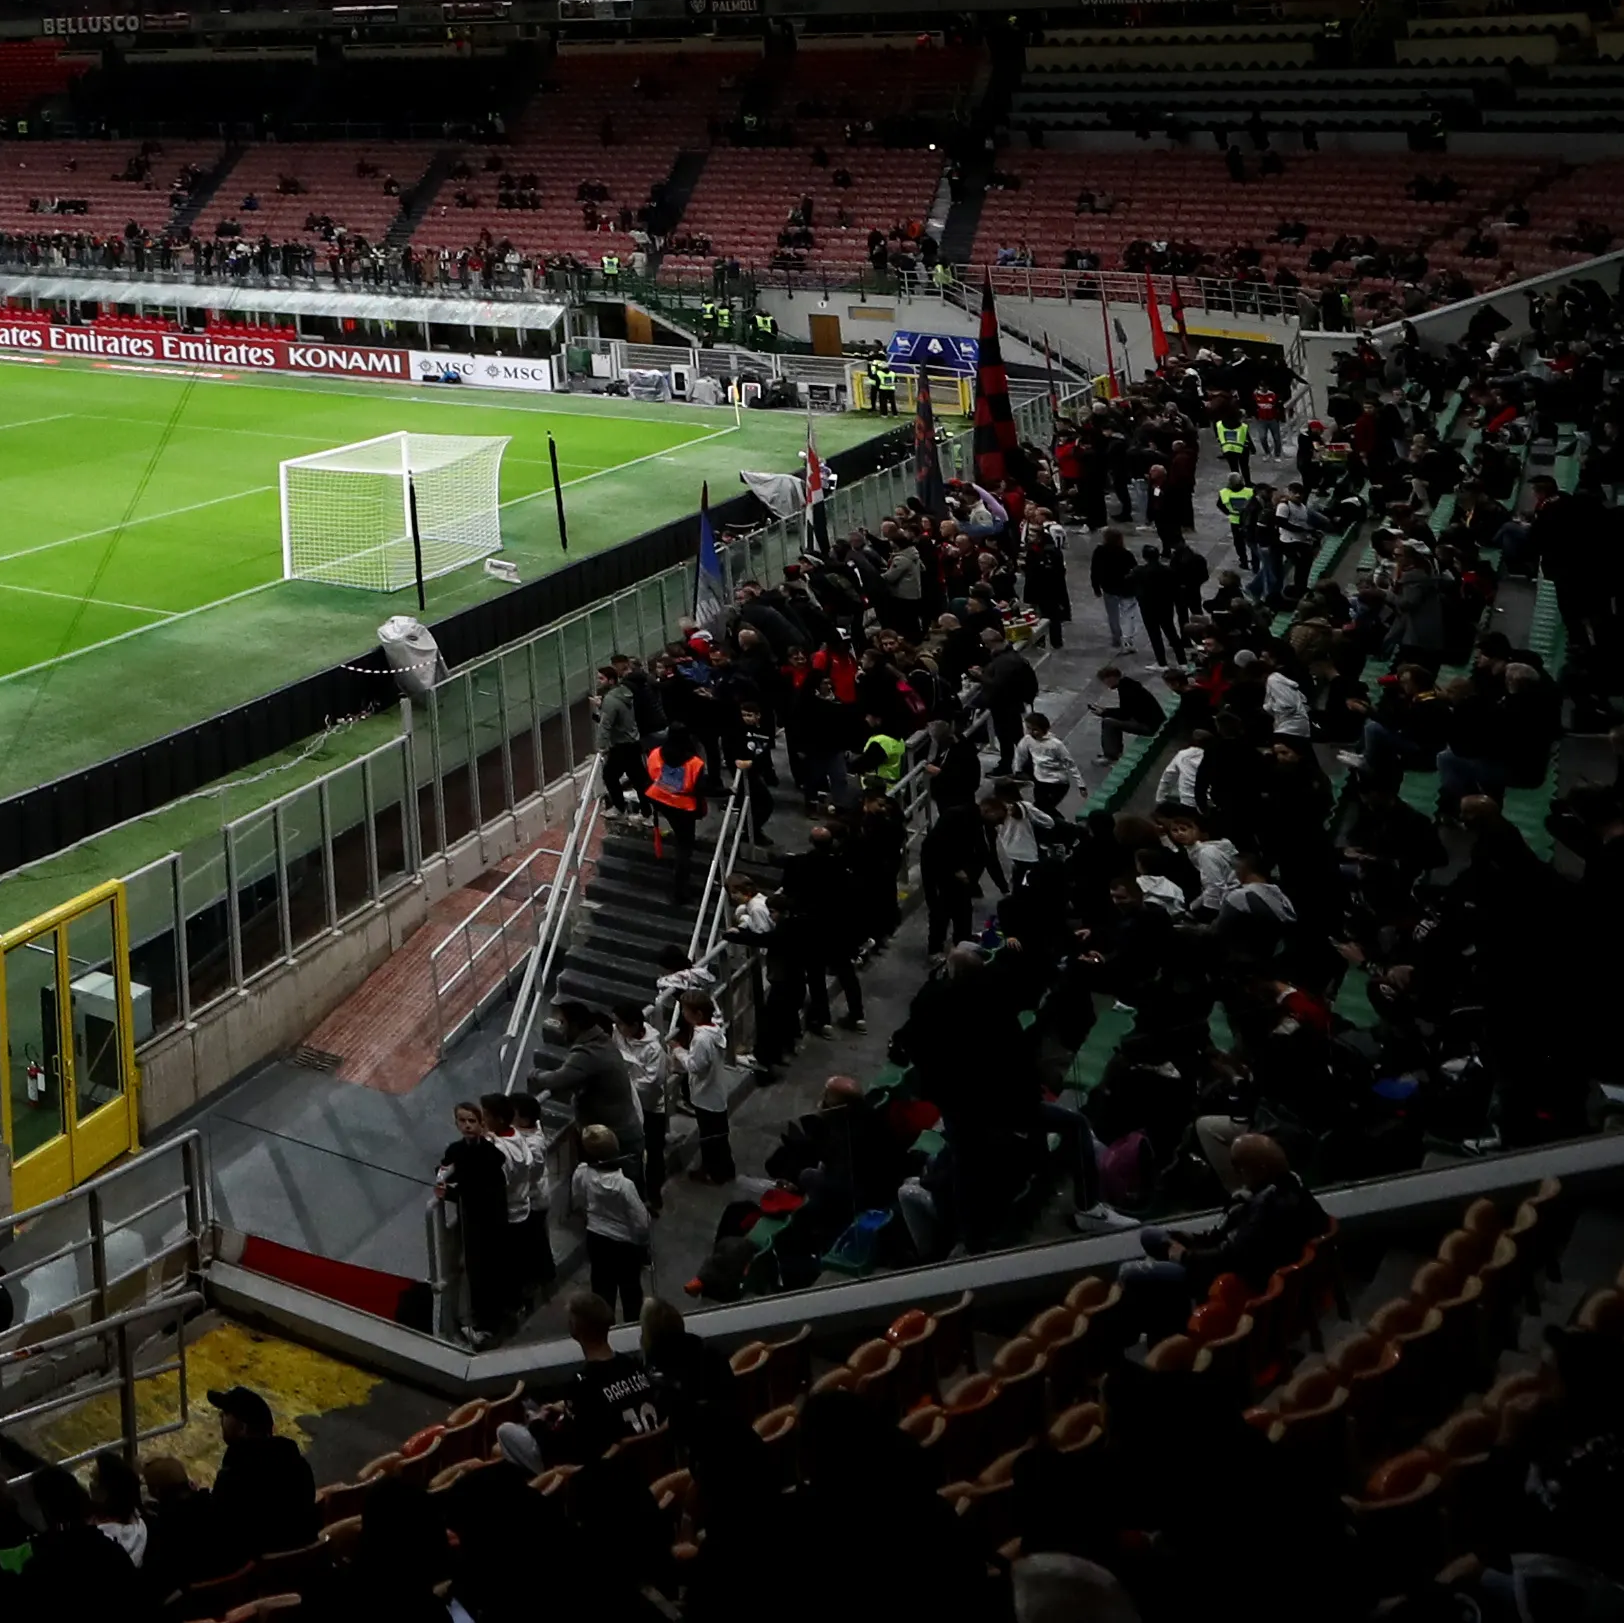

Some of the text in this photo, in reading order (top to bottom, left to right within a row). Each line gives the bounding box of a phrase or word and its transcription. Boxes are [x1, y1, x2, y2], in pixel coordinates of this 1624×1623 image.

[42, 15, 140, 35] BELLUSCO
[49, 328, 155, 357] Emirates
[161, 336, 276, 366] Emirates
[287, 346, 402, 375] KONAMI
[435, 360, 475, 376] MSC
[503, 366, 544, 381] MSC
[621, 1402, 658, 1435] 10
